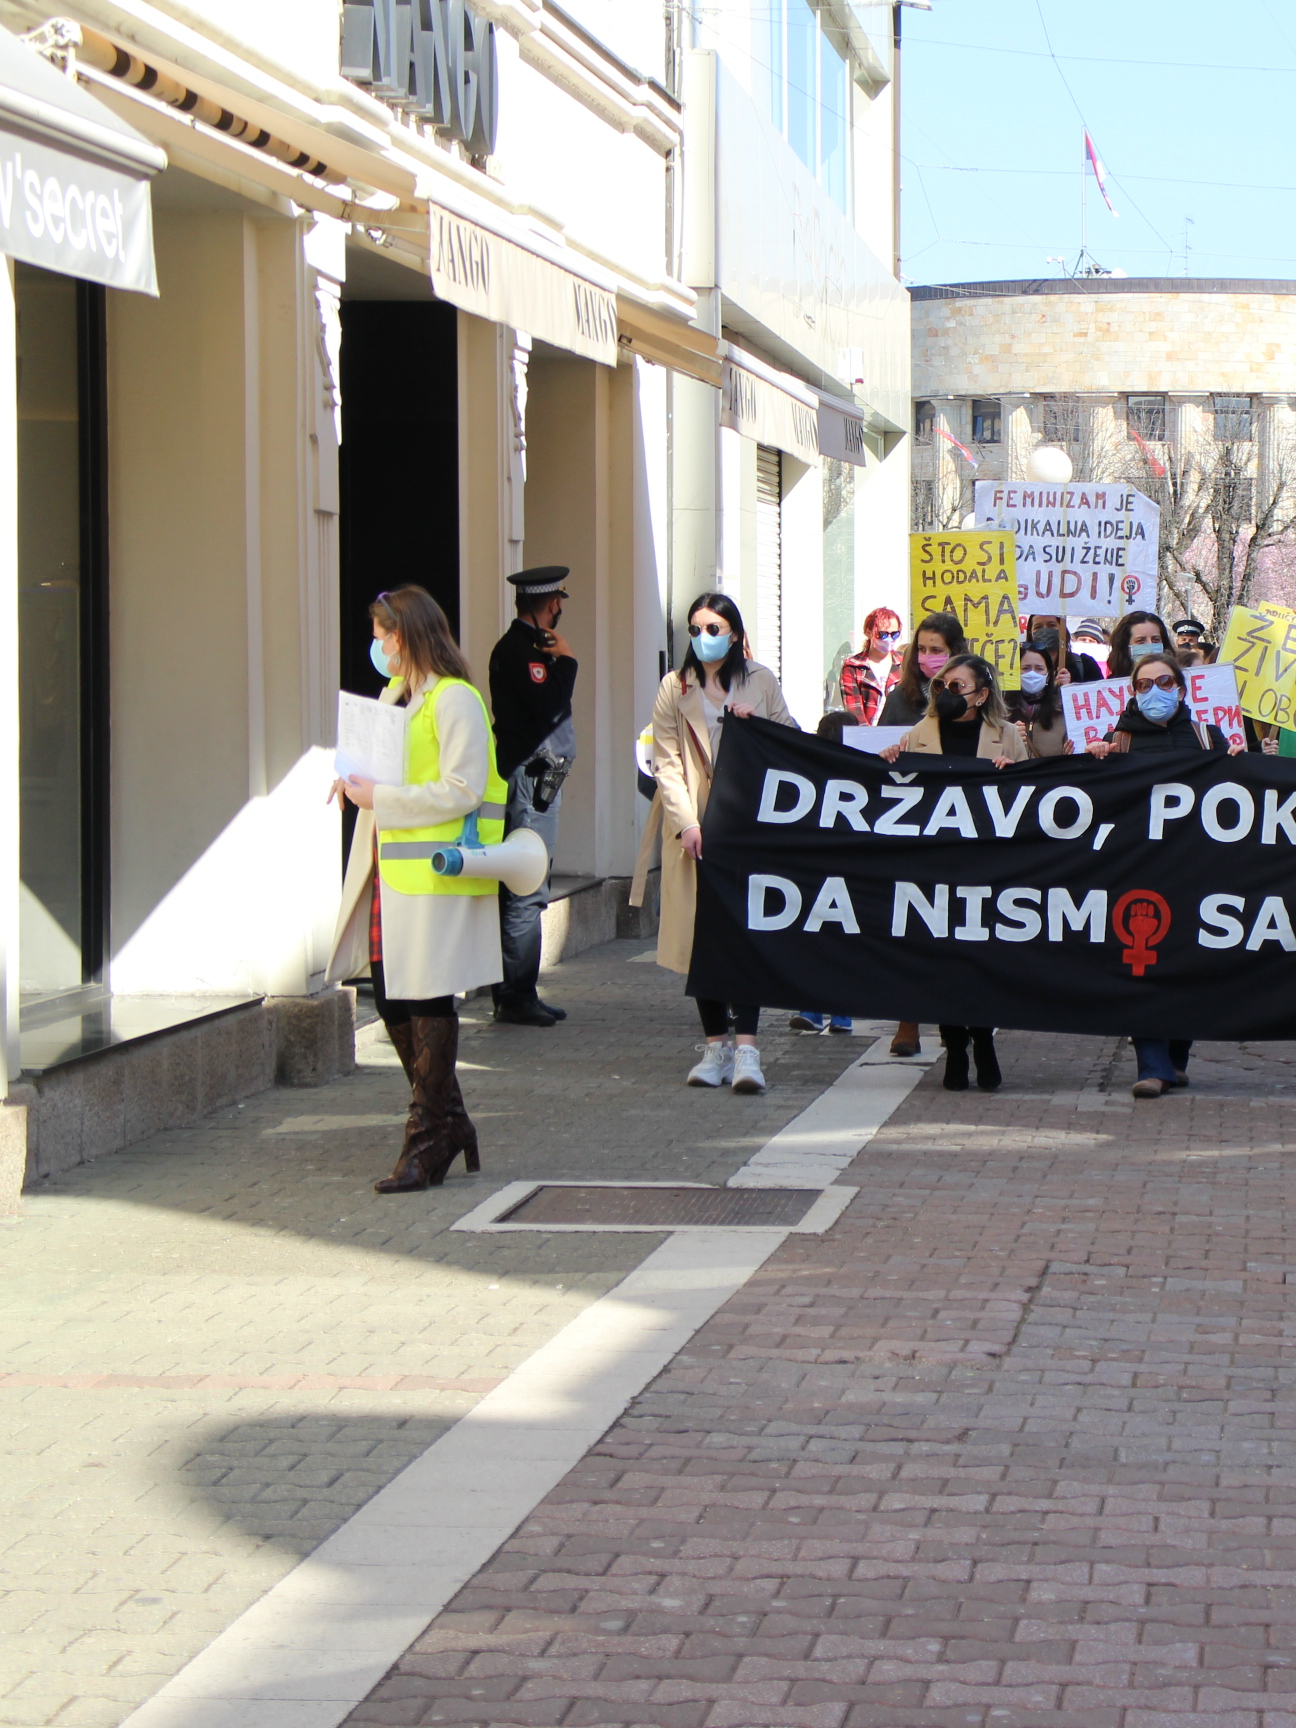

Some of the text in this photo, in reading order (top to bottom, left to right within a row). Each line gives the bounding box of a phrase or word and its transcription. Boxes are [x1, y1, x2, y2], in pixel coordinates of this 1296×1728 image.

[993, 490, 1135, 512] FEMINIZAM JE
[1097, 520, 1146, 541] IDEJA
[921, 537, 1005, 567] ŠTO SI
[1043, 545, 1064, 564] SU
[1080, 541, 1126, 567] ŽENE
[922, 569, 1009, 587] HODALA
[757, 769, 1115, 851] DRŽAVO,
[747, 874, 861, 934] DA
